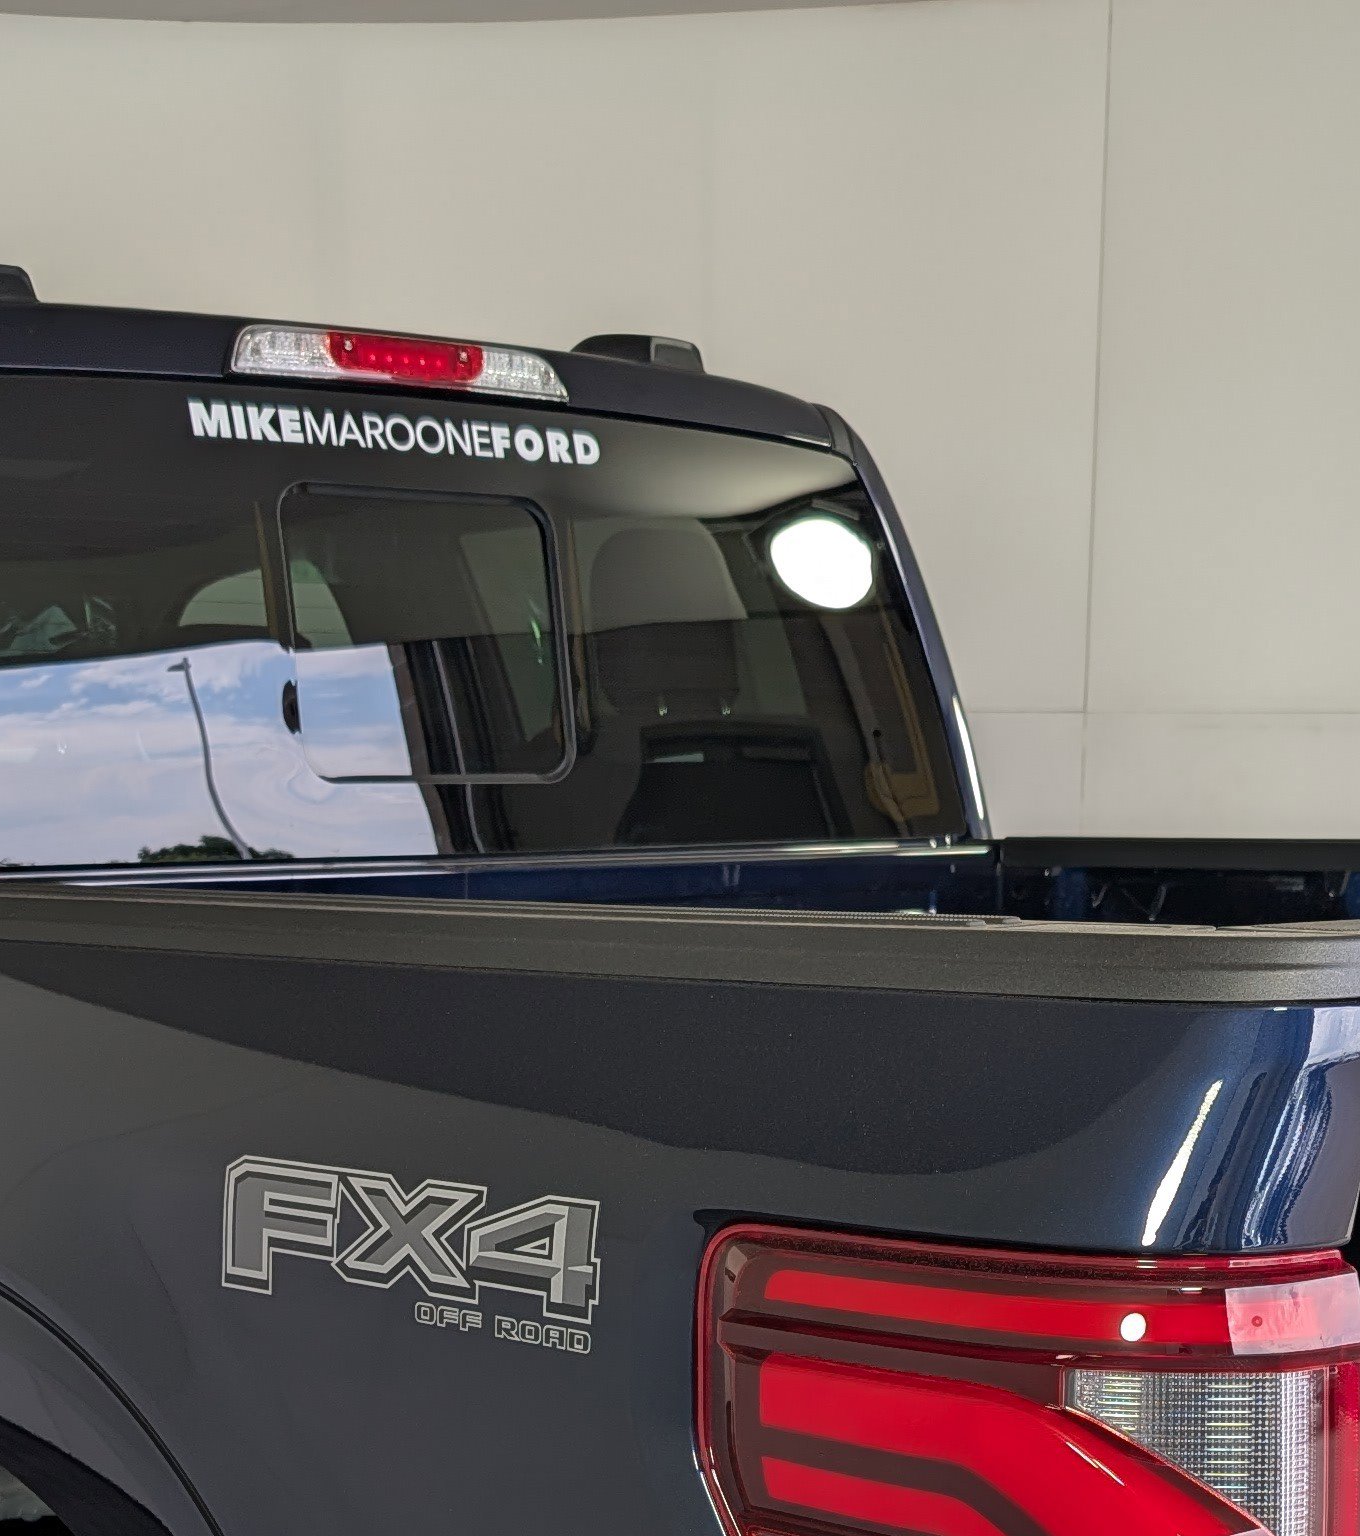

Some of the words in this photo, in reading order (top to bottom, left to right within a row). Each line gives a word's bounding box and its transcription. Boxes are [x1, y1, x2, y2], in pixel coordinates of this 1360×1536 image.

[222, 1155, 601, 1324] FX4
[415, 1302, 482, 1330] OFF
[495, 1315, 591, 1354] ROAD
